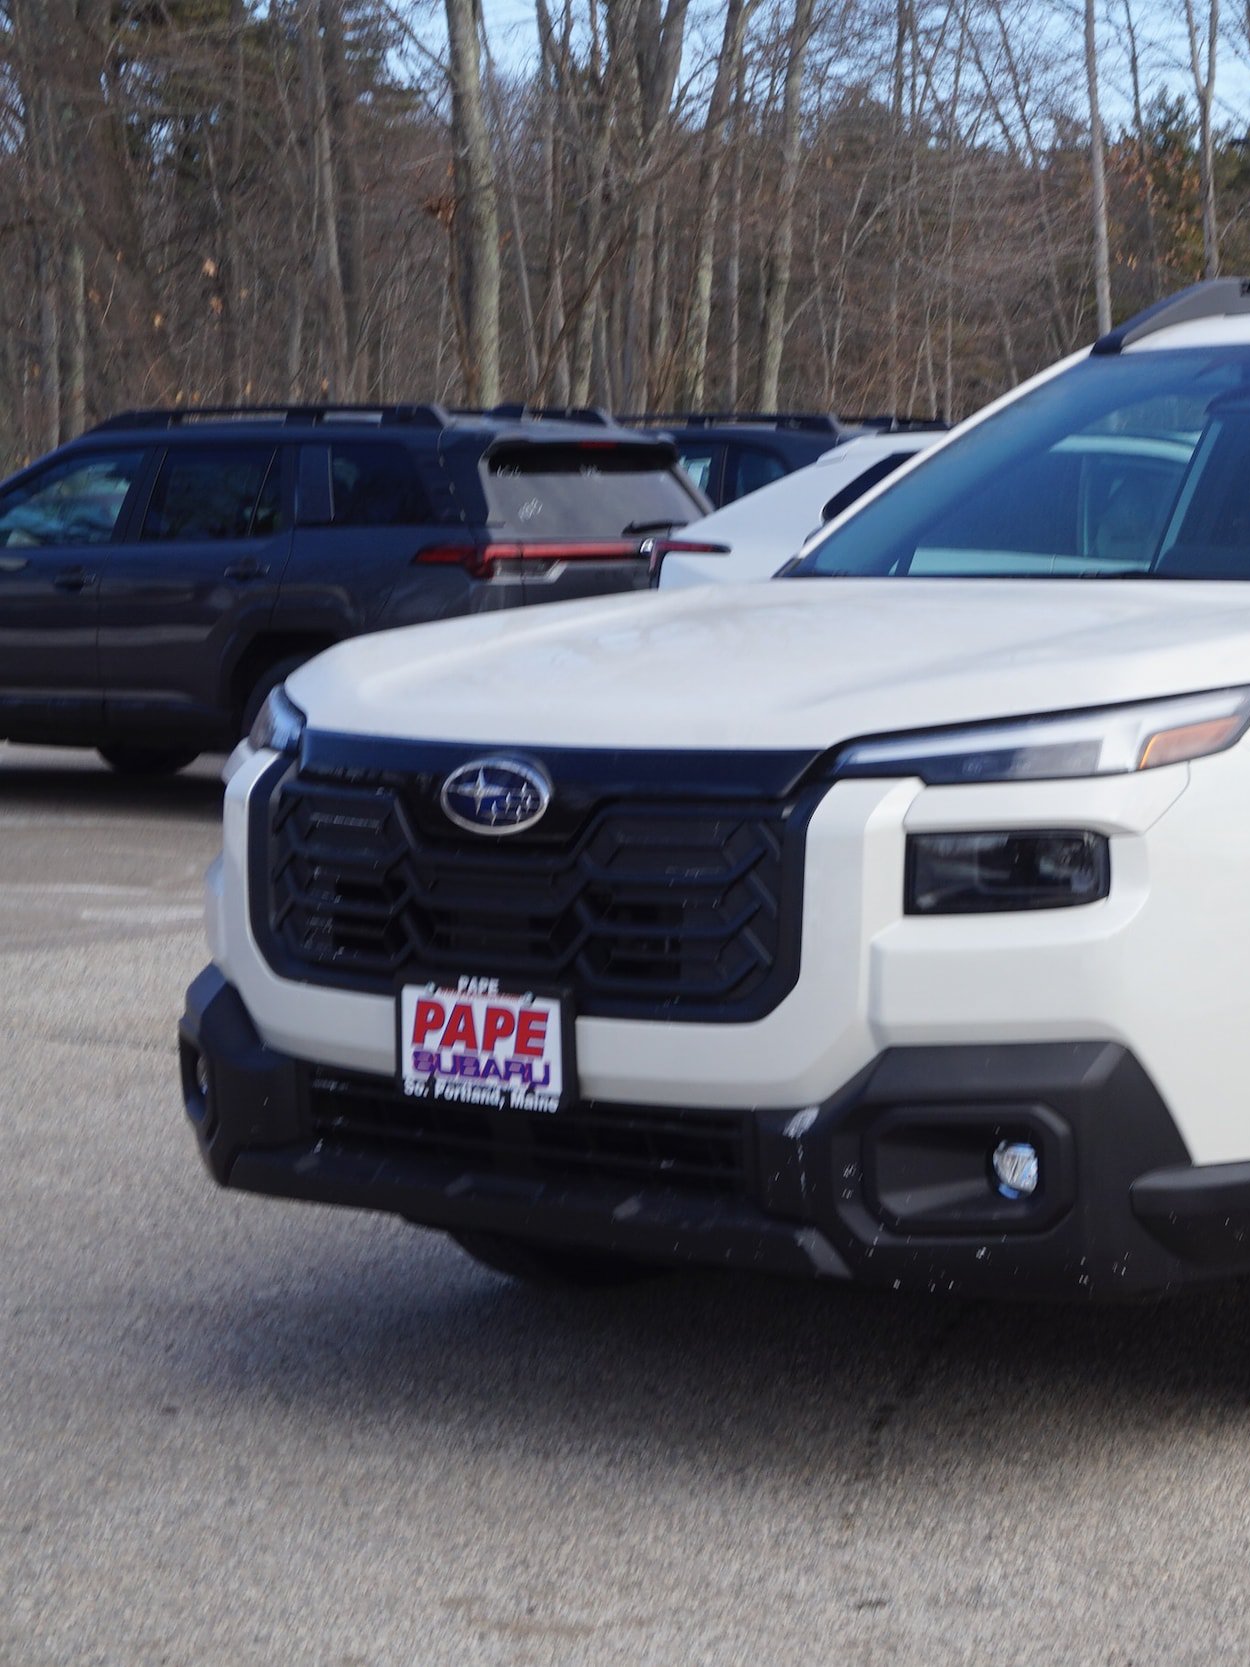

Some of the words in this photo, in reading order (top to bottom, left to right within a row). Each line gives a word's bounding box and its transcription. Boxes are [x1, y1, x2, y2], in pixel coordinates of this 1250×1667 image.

[457, 974, 499, 994] PAPE
[411, 1000, 549, 1057] PAPE
[412, 1050, 550, 1088] SUBARU
[509, 1087, 560, 1114] Maine
